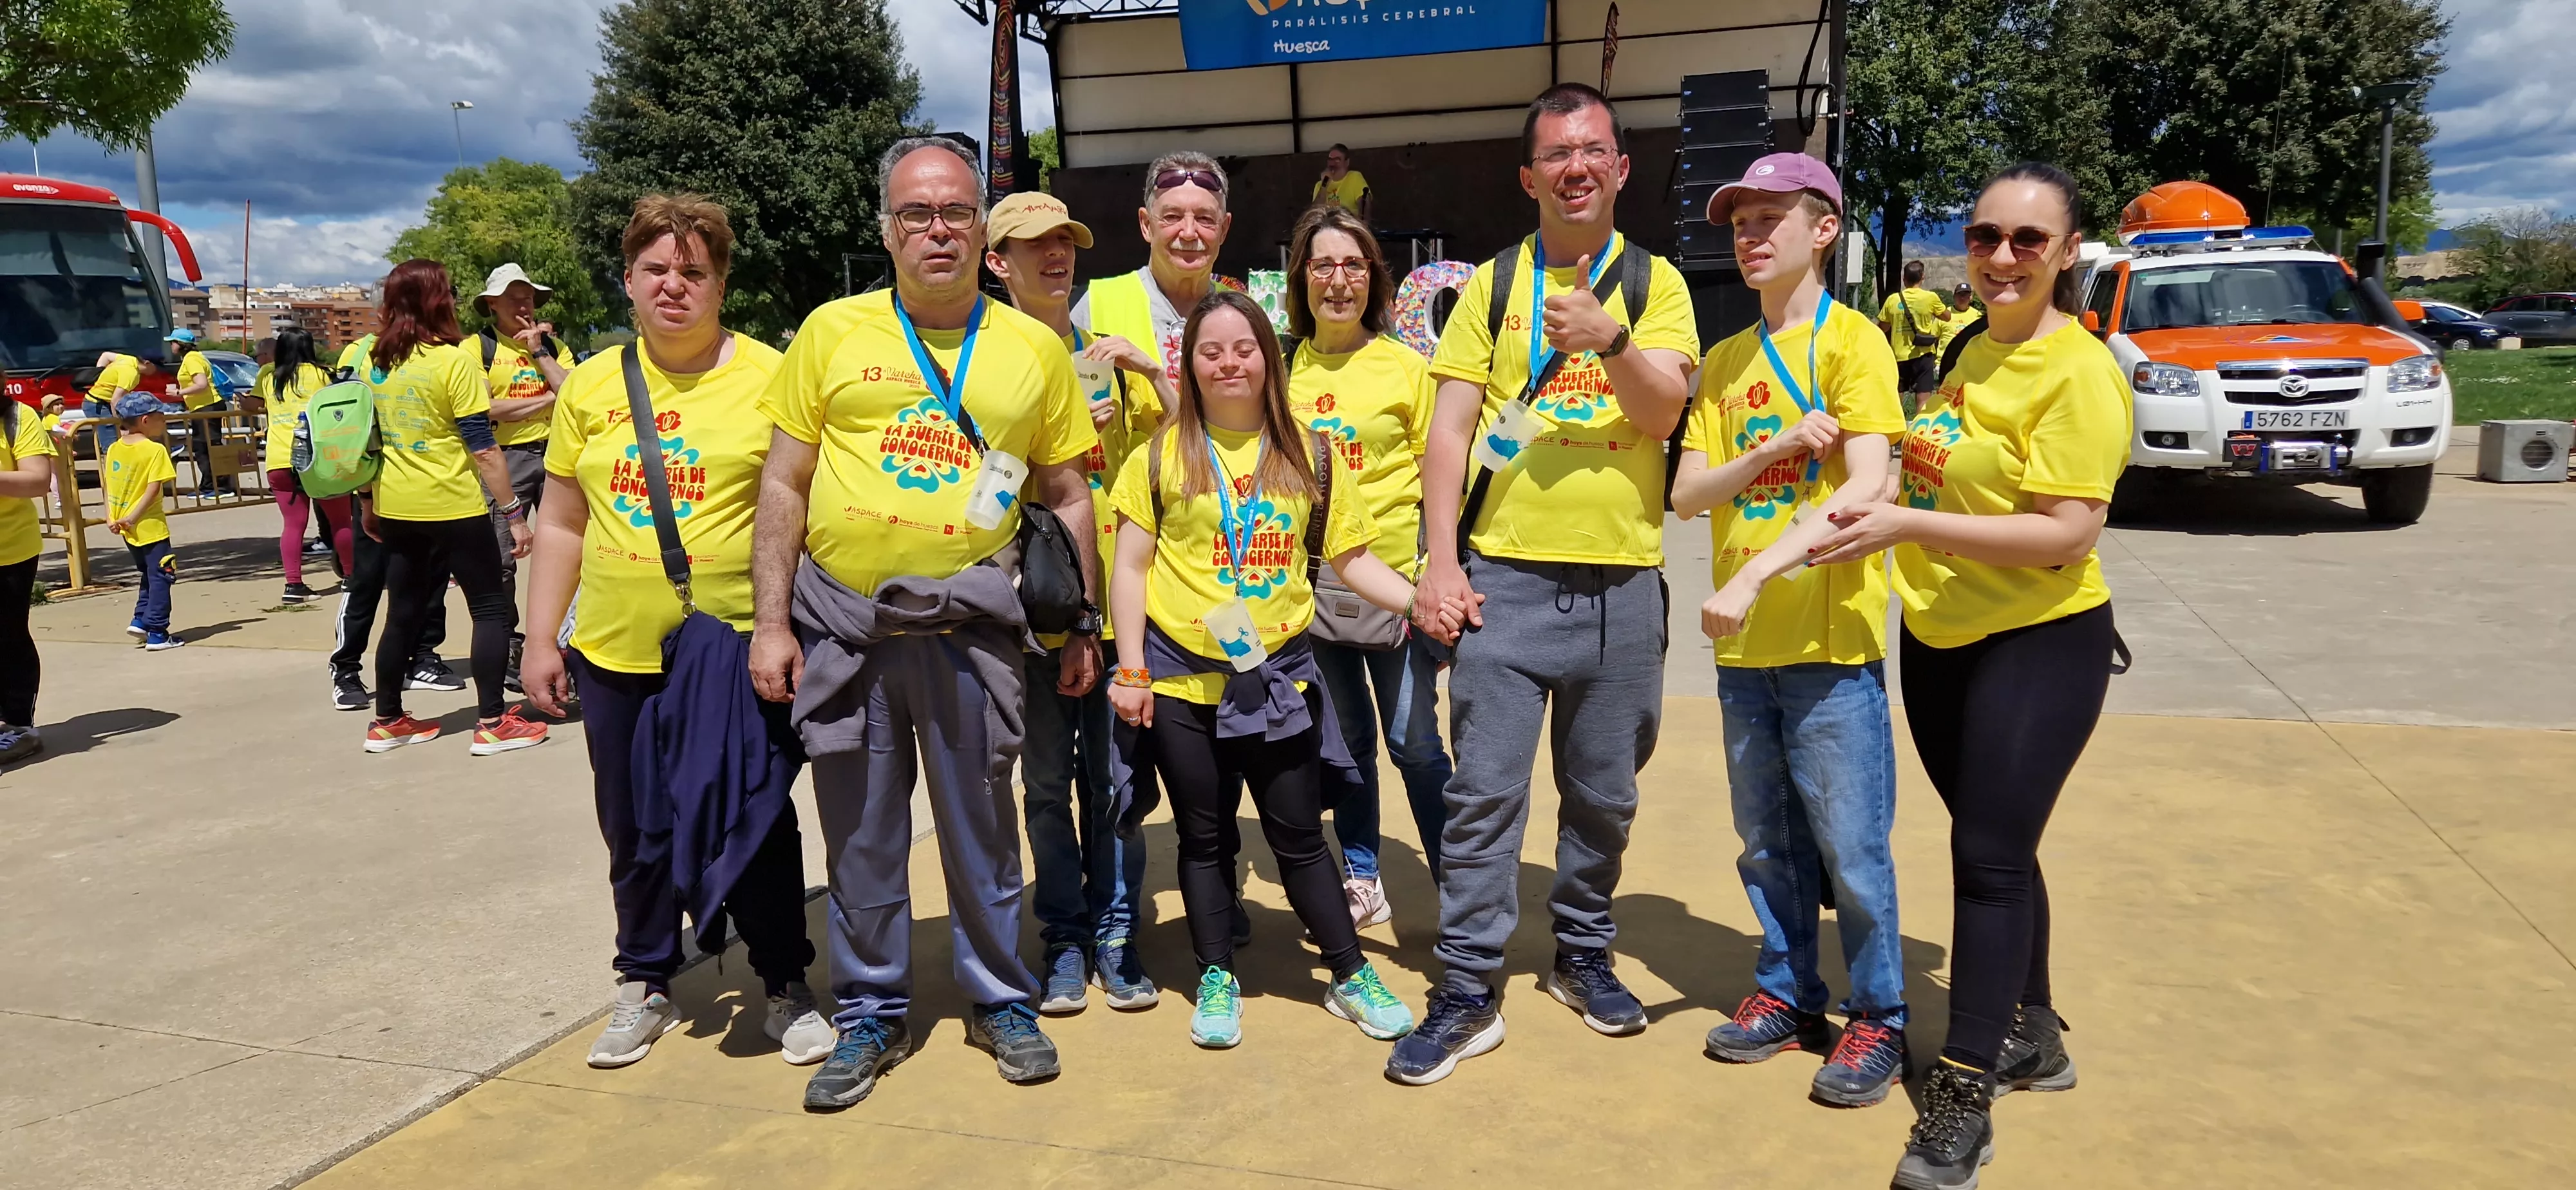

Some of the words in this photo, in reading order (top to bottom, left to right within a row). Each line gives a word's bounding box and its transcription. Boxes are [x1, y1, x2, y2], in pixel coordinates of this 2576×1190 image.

[1272, 15, 1368, 28] PARÁLISIS
[1383, 5, 1475, 21] CEREBRAL
[1273, 39, 1331, 53] Huesca
[1504, 315, 1520, 331] 13
[860, 366, 882, 381] 13
[886, 366, 923, 380] Marcha
[1553, 368, 1602, 383] SUERTE
[1540, 378, 1615, 397] ONOCERNO
[2257, 413, 2303, 427] 5762
[2311, 411, 2346, 426] FZN
[885, 425, 903, 437] LA
[905, 425, 956, 448] SUERTE
[958, 435, 972, 453] DE
[880, 437, 971, 469] CONOCERNOS
[1350, 442, 1362, 456] DE
[1317, 446, 1327, 481] PACO
[1936, 448, 1951, 468] DE
[613, 459, 631, 477] LA
[636, 464, 685, 483] SRTE
[690, 467, 706, 484] DE
[610, 476, 705, 501] CONORNOS
[851, 506, 882, 518] ASPACE
[1235, 533, 1281, 549] SERTE
[1284, 533, 1296, 549] DE
[601, 545, 624, 556] ASPACE
[1213, 550, 1293, 566] COOCERNOS
